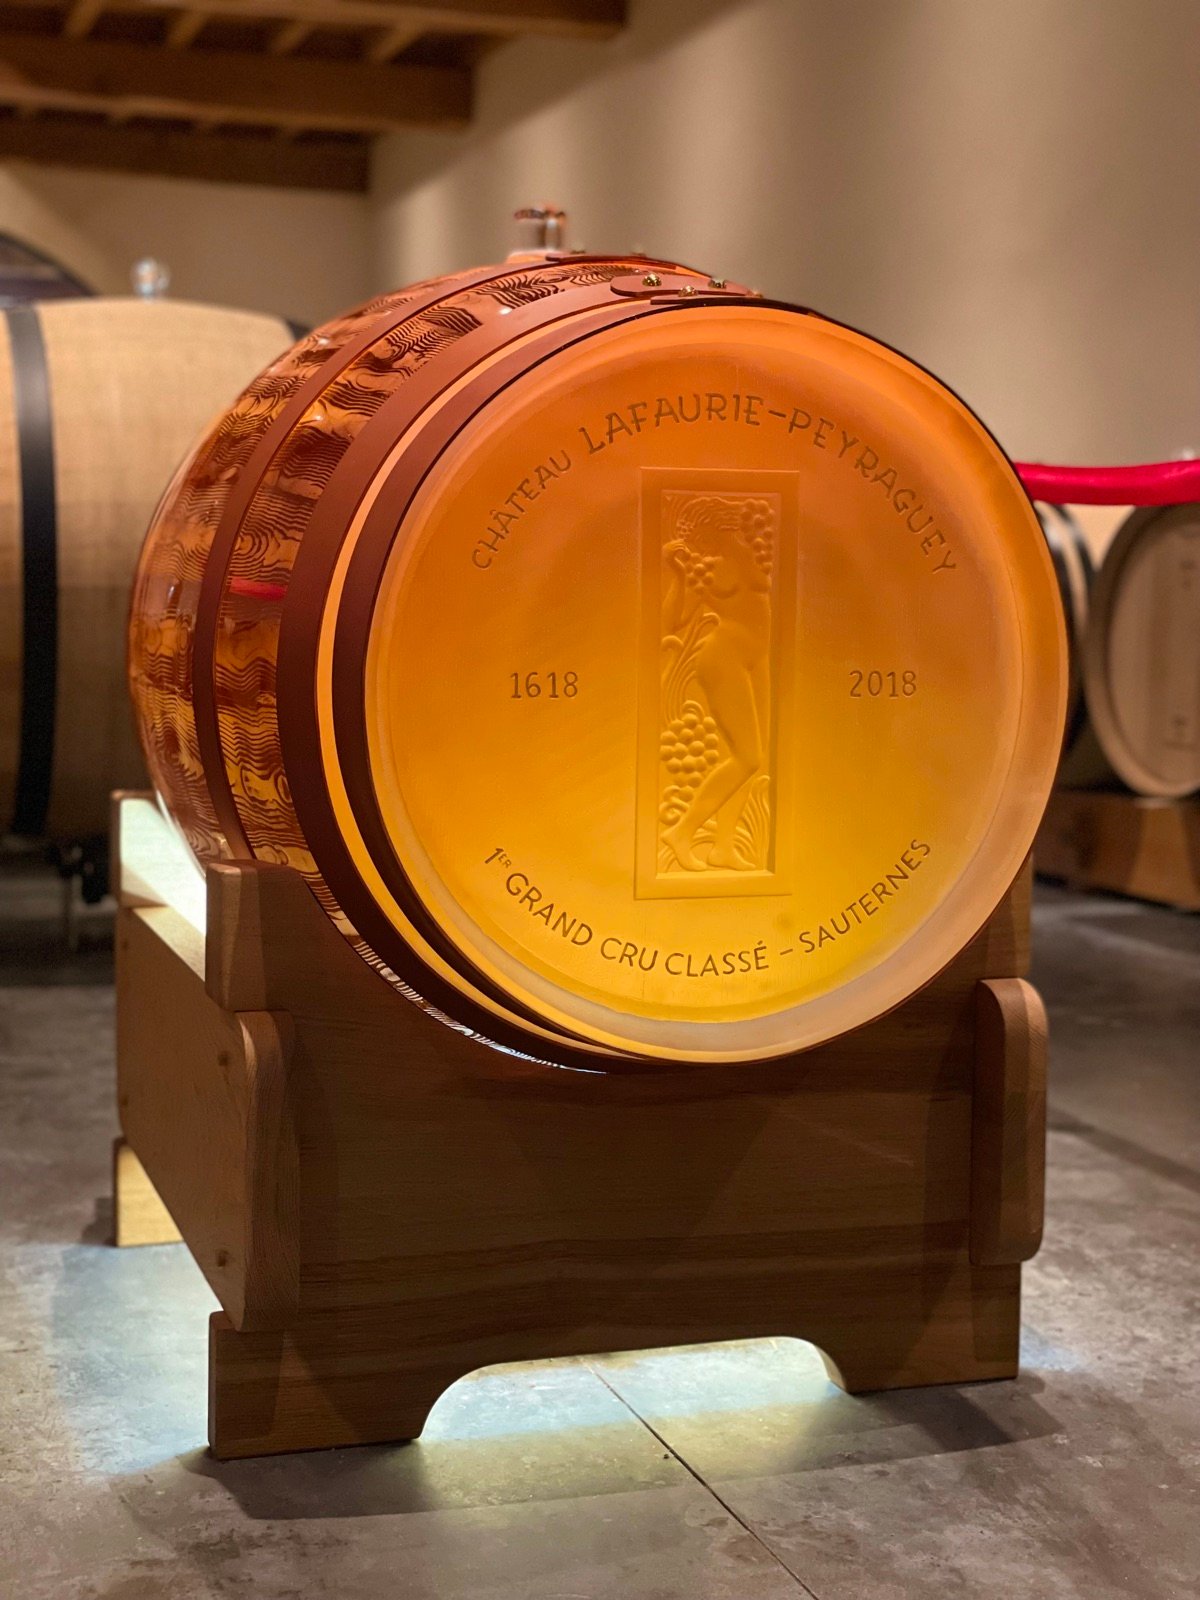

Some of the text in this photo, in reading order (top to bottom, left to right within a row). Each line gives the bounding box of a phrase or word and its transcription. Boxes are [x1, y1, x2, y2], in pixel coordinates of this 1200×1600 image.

[471, 392, 958, 575] CHÂTEAU LAFAURIE-PEYRAGUEY
[509, 670, 579, 699] 1618
[848, 669, 918, 698] 2018
[504, 871, 594, 947] GRAND
[599, 936, 659, 973] CRU
[664, 939, 770, 978] CLASSÉ
[798, 838, 932, 954] SAUTERNES
